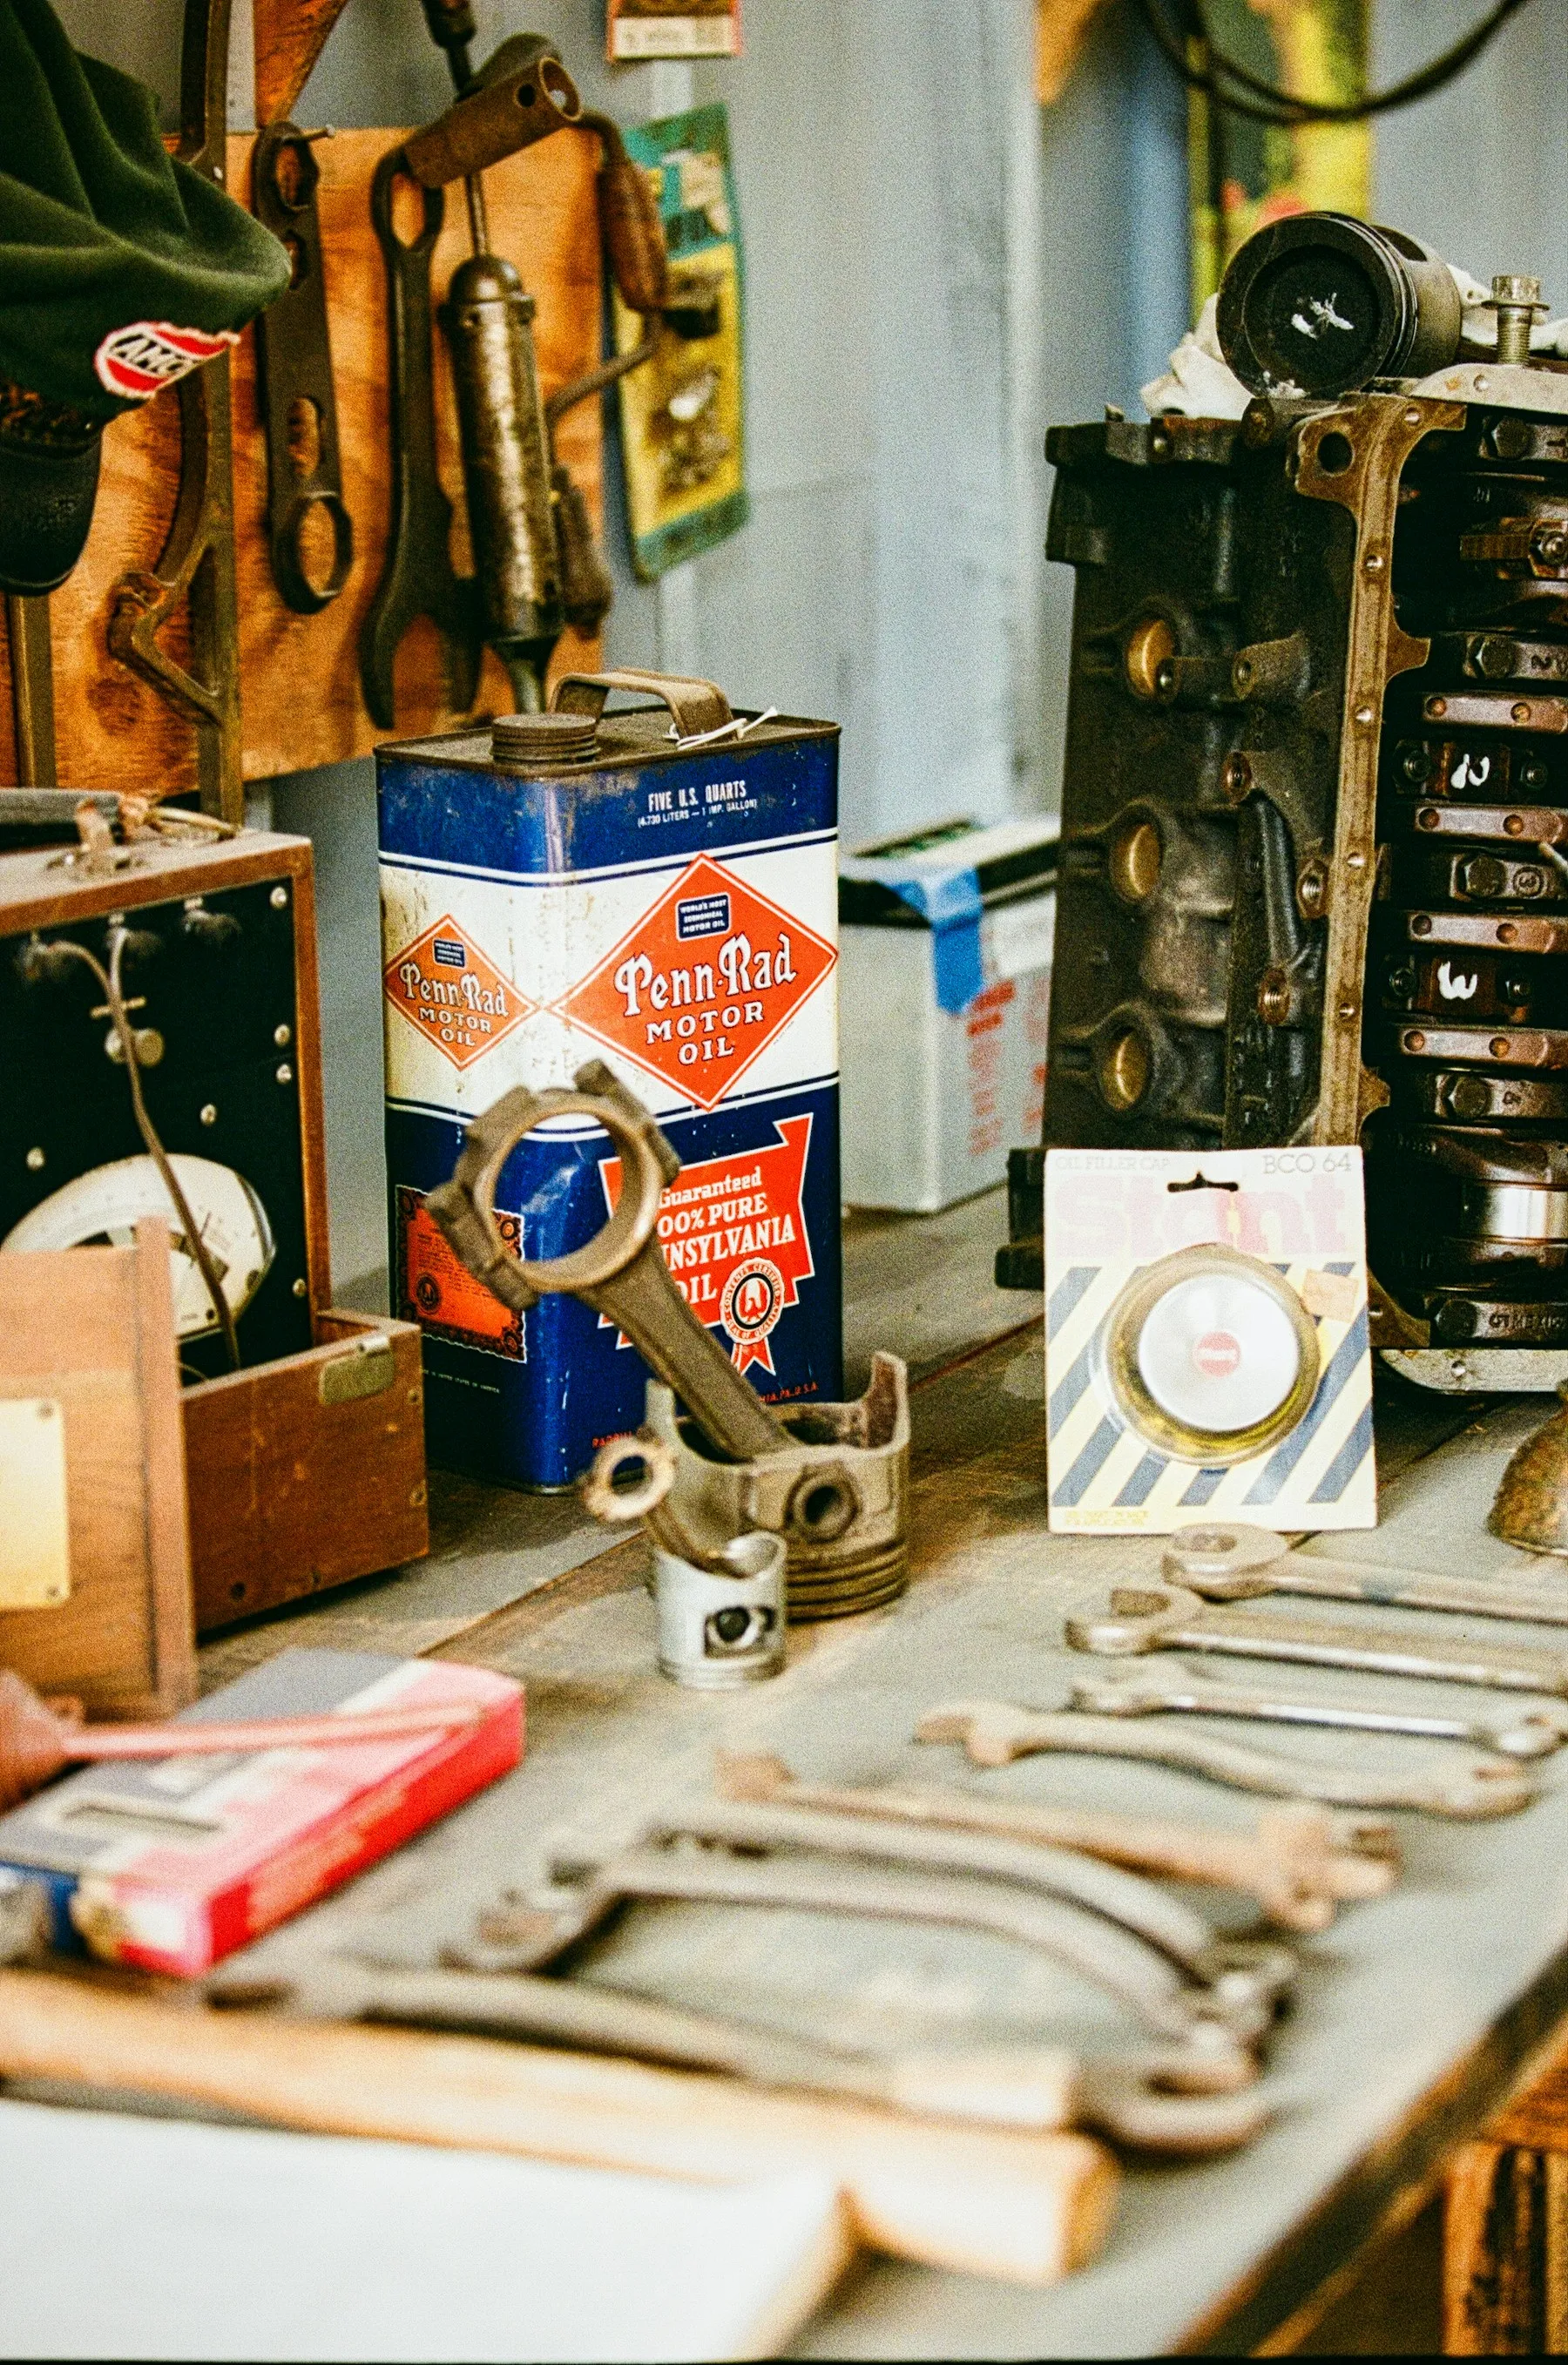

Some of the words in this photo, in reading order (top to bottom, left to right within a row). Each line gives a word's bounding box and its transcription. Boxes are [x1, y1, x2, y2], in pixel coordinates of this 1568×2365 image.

[648, 791, 672, 813] FIVE
[678, 787, 699, 807] U.S.
[705, 780, 747, 803] QUARTS
[662, 808, 689, 823] LITERS
[727, 798, 758, 812] GALLON)
[708, 899, 727, 909] MOST
[683, 922, 711, 933] MOTOR
[1437, 960, 1478, 1000] 3
[419, 1007, 491, 1034] MOTOR
[645, 1001, 764, 1044] MOTOR
[441, 1028, 476, 1046] OIL
[678, 1037, 734, 1065] OIL
[1055, 1157, 1083, 1171] OIL
[1085, 1157, 1139, 1171] FILLER
[1139, 1156, 1171, 1171] CAP
[1261, 1152, 1316, 1175] BCO
[1321, 1152, 1352, 1173] 64
[659, 1166, 763, 1208] Guaranteed
[657, 1207, 705, 1239] 00%
[707, 1192, 768, 1226] PURE
[1054, 1172, 1348, 1258] Stant
